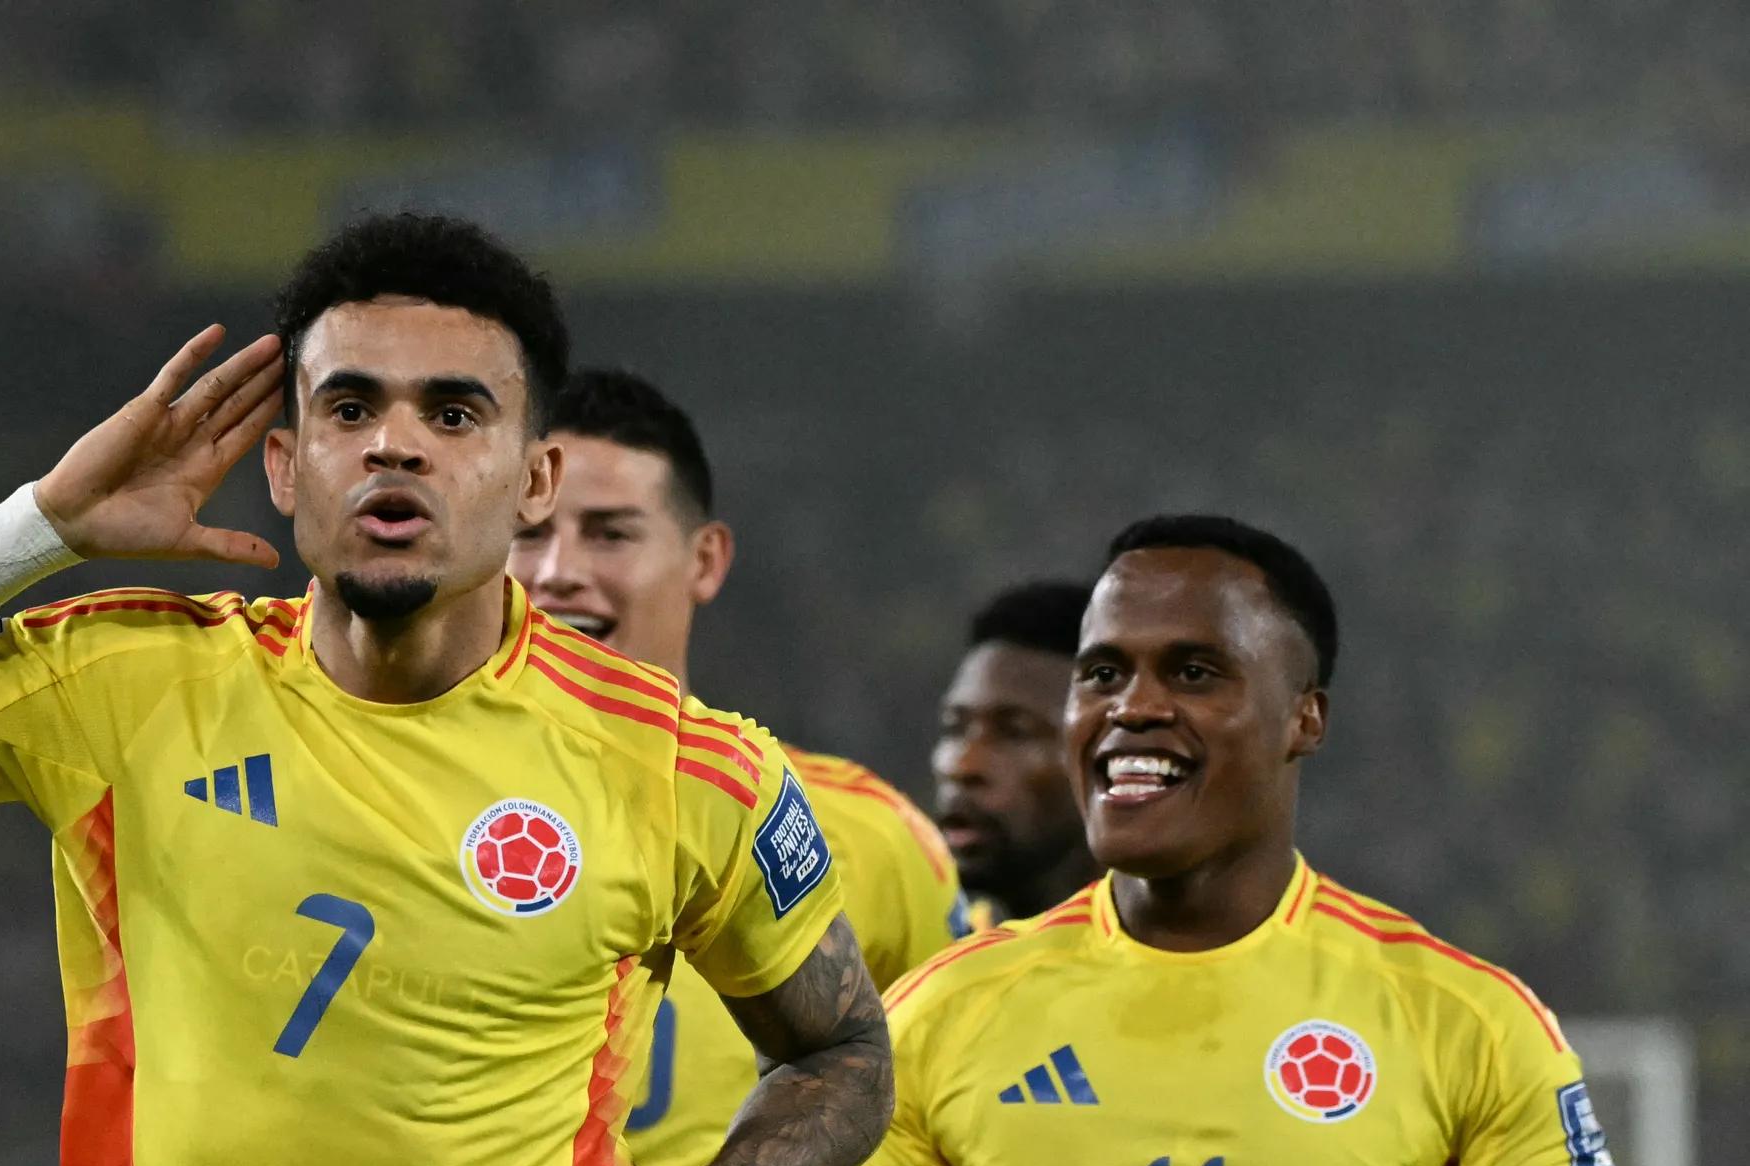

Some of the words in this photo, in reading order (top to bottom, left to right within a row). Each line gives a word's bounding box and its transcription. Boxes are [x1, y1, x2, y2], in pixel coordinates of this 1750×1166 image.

[466, 806, 502, 847] FEDERACION
[503, 802, 557, 823] COLOMBIANA
[556, 822, 567, 833] DE
[564, 831, 578, 862] FUTBOL
[770, 798, 800, 849] FOOTBALL
[777, 808, 808, 862] UNITES
[779, 859, 798, 880] the
[799, 856, 816, 877] FIFA
[273, 893, 375, 1058] 7
